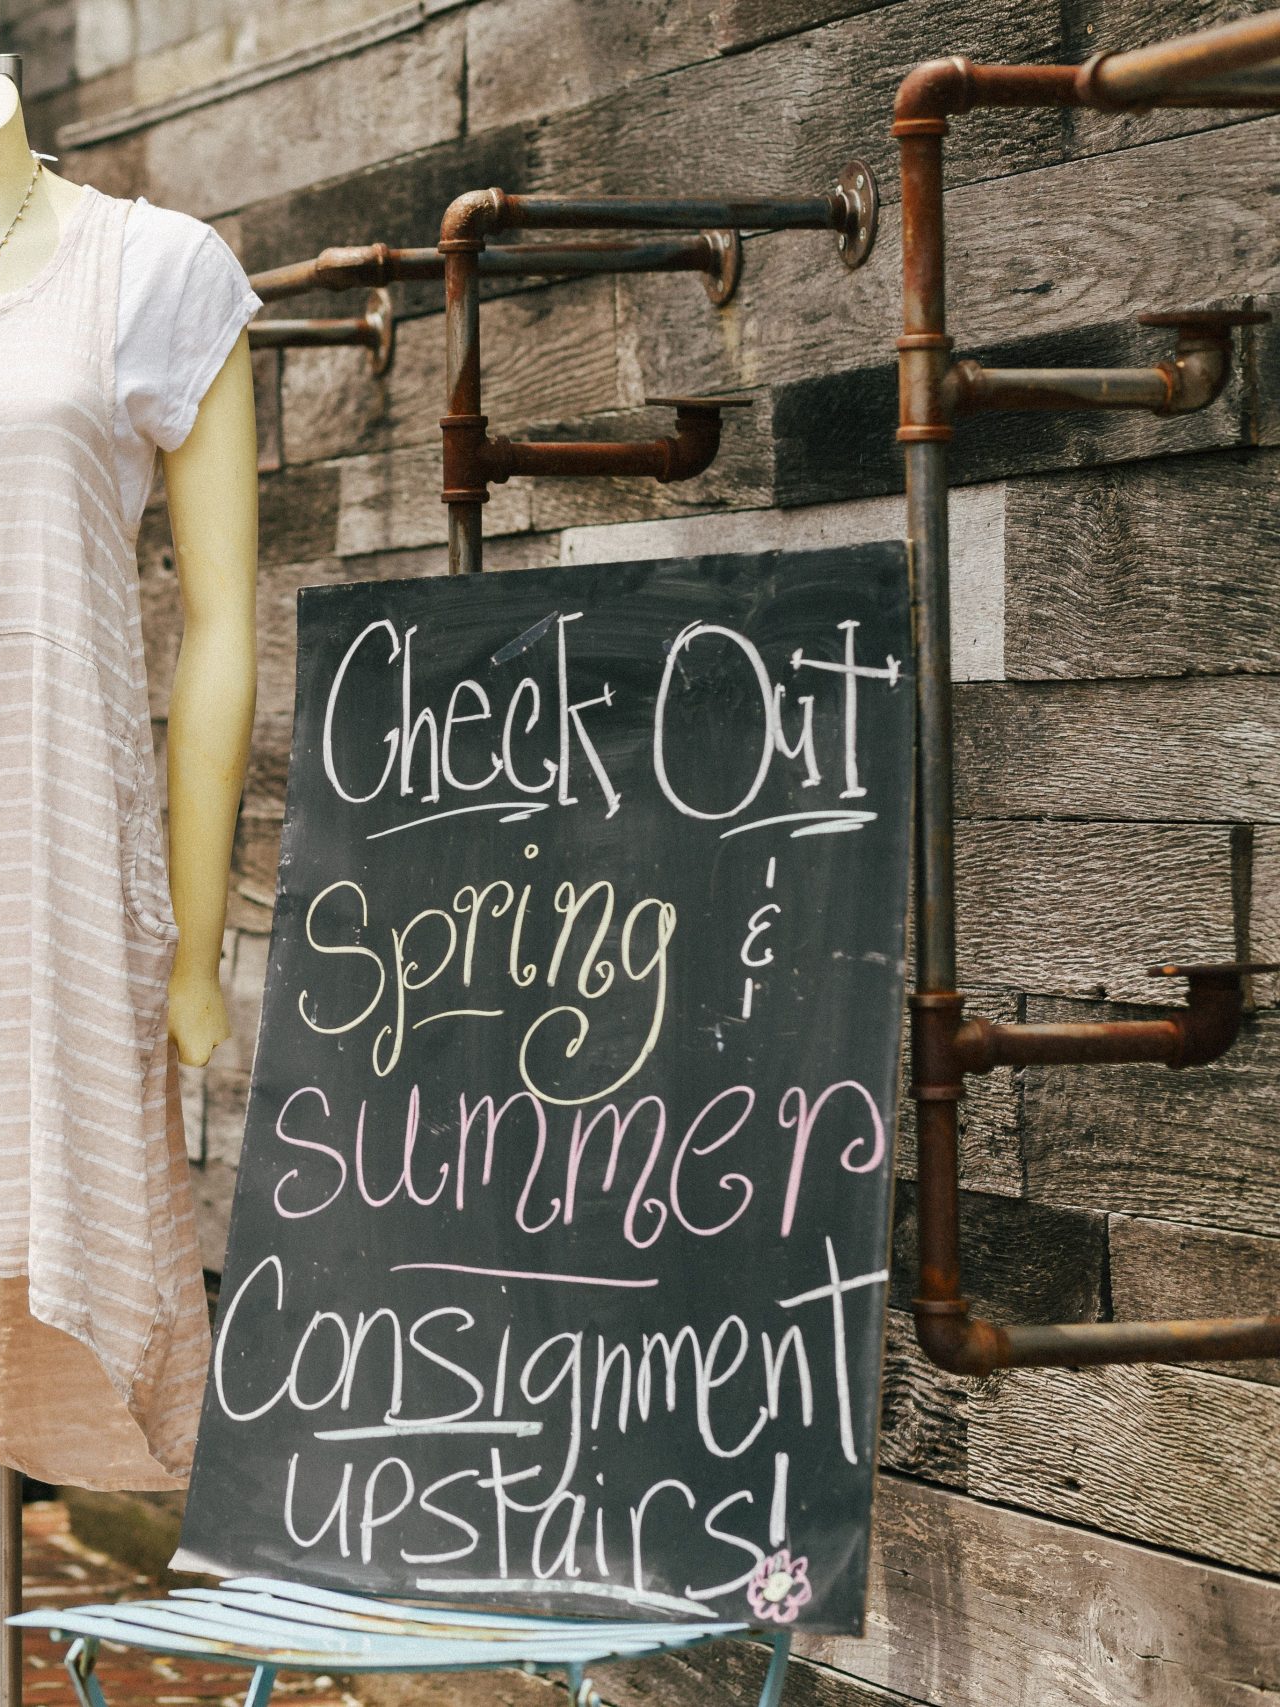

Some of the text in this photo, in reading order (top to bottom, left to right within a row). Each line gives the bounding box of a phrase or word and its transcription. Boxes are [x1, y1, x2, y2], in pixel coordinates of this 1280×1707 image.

[322, 613, 902, 820] Check Out
[298, 842, 781, 1106] Spring &
[215, 1236, 890, 1512] Consignment
